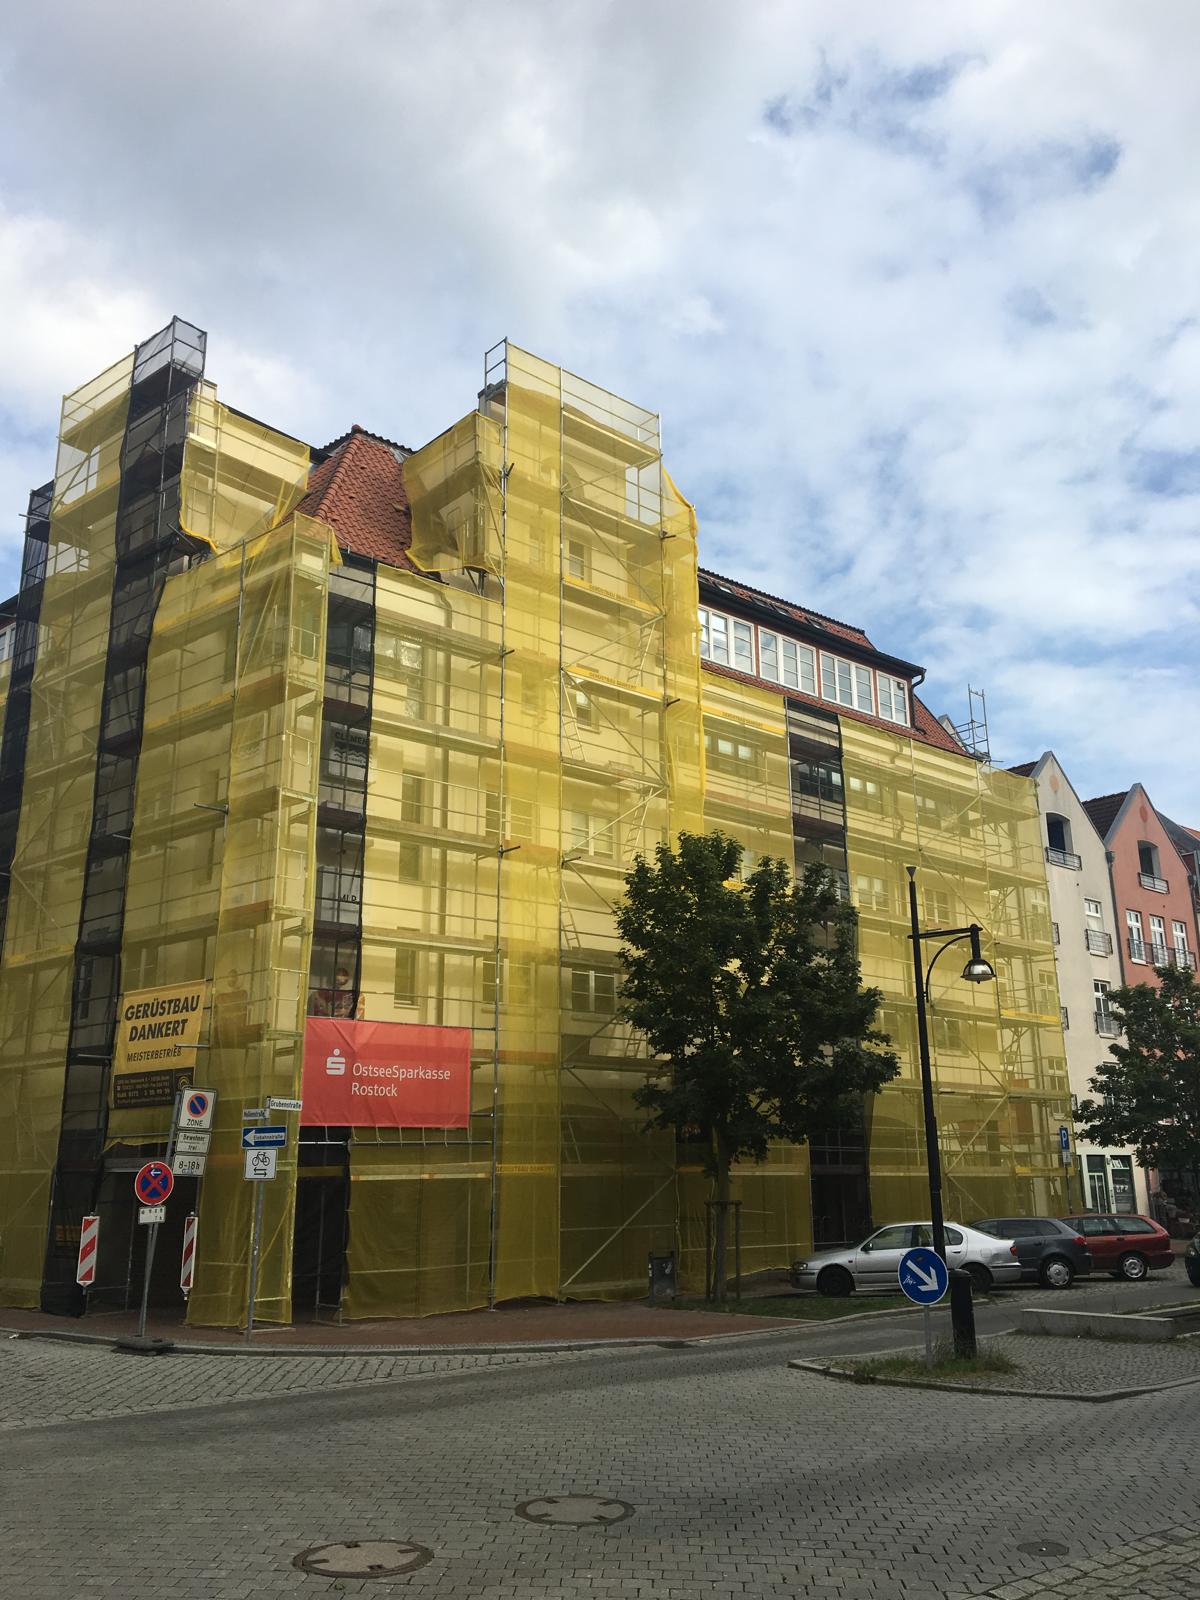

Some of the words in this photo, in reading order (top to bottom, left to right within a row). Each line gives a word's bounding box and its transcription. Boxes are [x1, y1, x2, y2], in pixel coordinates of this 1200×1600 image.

[124, 994, 200, 1021] GERÜSTBAU
[128, 1019, 188, 1041] DANKERT
[126, 1047, 181, 1062] MEISTERBETRIEB
[352, 1062, 451, 1081] OstseeSparkasse
[351, 1082, 398, 1097] Rostock
[270, 1100, 302, 1109] Grubenstraße
[186, 1118, 204, 1127] ZONE
